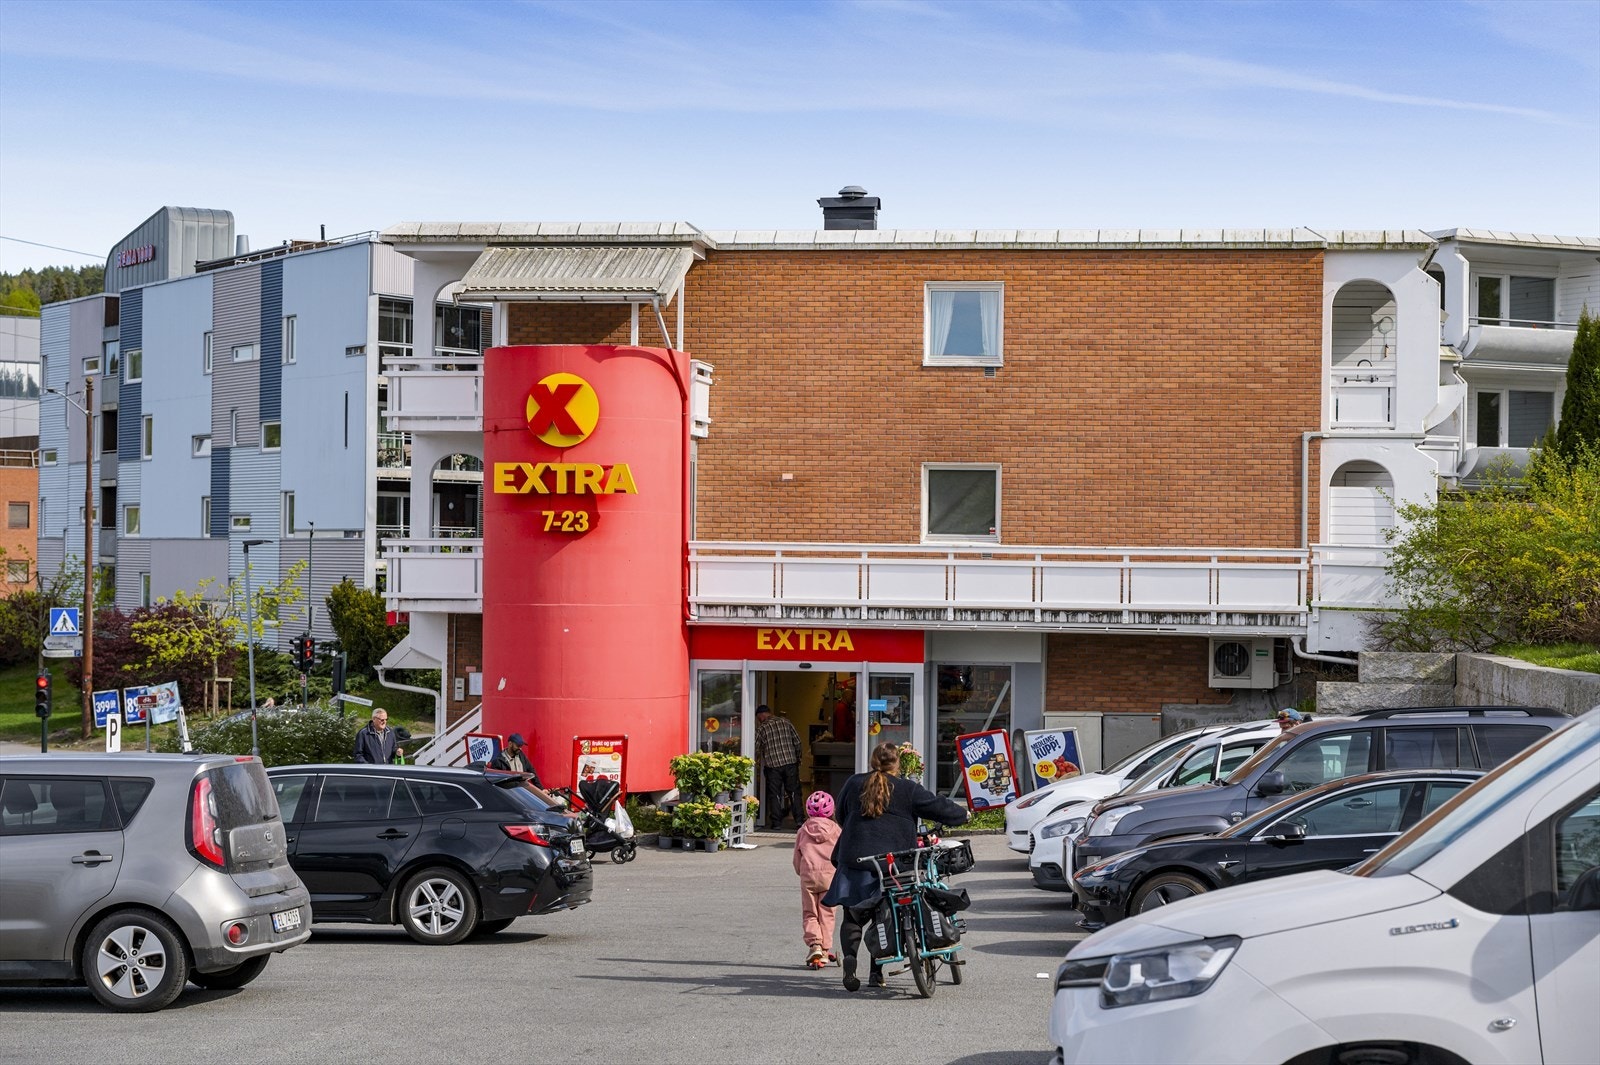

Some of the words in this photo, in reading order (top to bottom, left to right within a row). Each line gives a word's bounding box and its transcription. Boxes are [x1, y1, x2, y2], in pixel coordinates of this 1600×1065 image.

[528, 384, 585, 436] X
[493, 462, 639, 495] EXTRA
[542, 510, 589, 532] 7-23
[757, 628, 855, 651] EXTRA
[95, 700, 110, 713] 399
[110, 718, 118, 748] P
[1030, 735, 1056, 751] MEDLEMS-
[471, 744, 490, 762] KUPP!
[964, 742, 992, 765] KUPP!
[1033, 739, 1061, 760] KUPP!
[969, 768, 987, 777] -40%
[1038, 764, 1049, 773] 29
[1389, 921, 1451, 936] ELECTRIC
